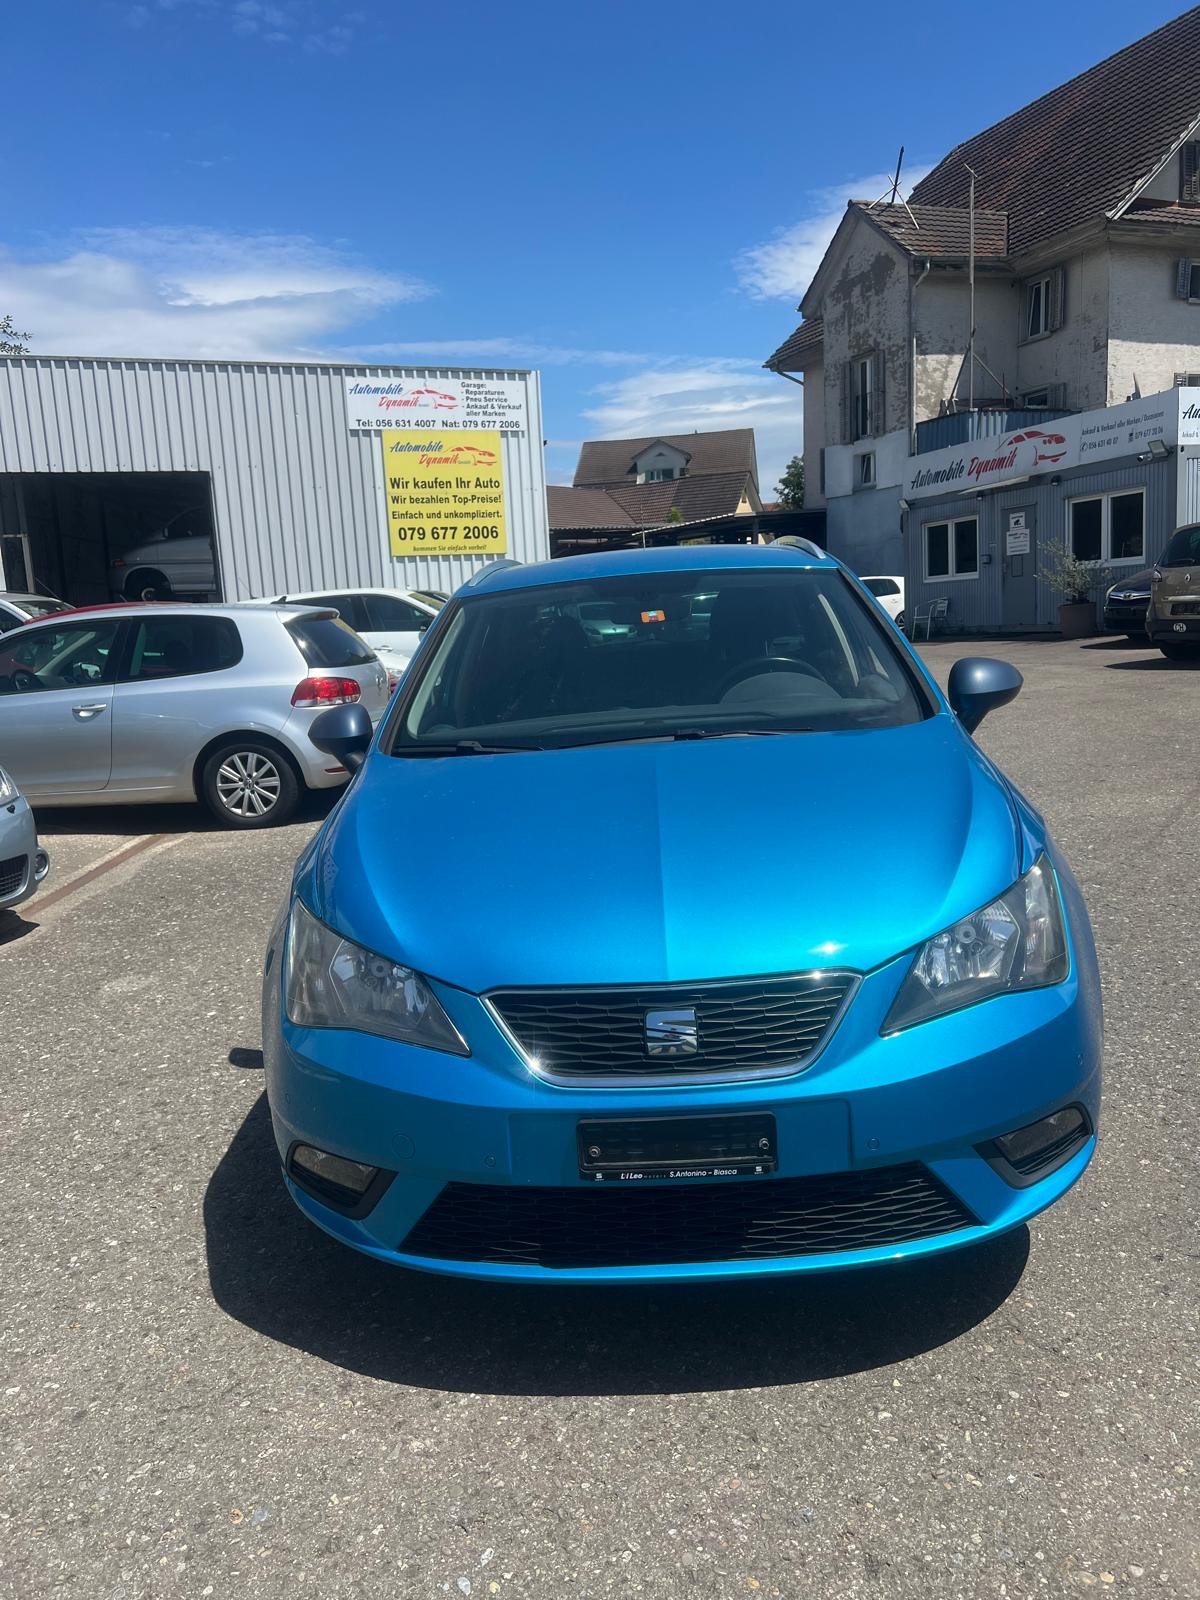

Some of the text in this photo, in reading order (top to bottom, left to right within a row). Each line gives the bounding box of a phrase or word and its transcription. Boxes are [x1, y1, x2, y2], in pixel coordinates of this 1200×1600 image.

[348, 383, 403, 395] Automobile
[378, 396, 420, 410] Dynamik
[356, 419, 373, 427] Tel:
[375, 419, 392, 427] 056
[395, 419, 411, 428] 631
[414, 420, 436, 428] 4007
[441, 420, 460, 428] Nat:
[462, 420, 478, 428] 079
[481, 420, 496, 428] 677
[389, 440, 444, 453] Automobile
[418, 453, 459, 468] Dynamik
[910, 447, 1018, 490] Automobile Dynamik
[390, 477, 500, 489] Wir kaufen Ihr Auto
[391, 494, 502, 505] Wir bezahlen Top-Preise!
[392, 510, 502, 520] Einfach und unkompliziert.
[398, 526, 499, 541] 079 677 2006
[713, 1168, 737, 1176] Biasca
